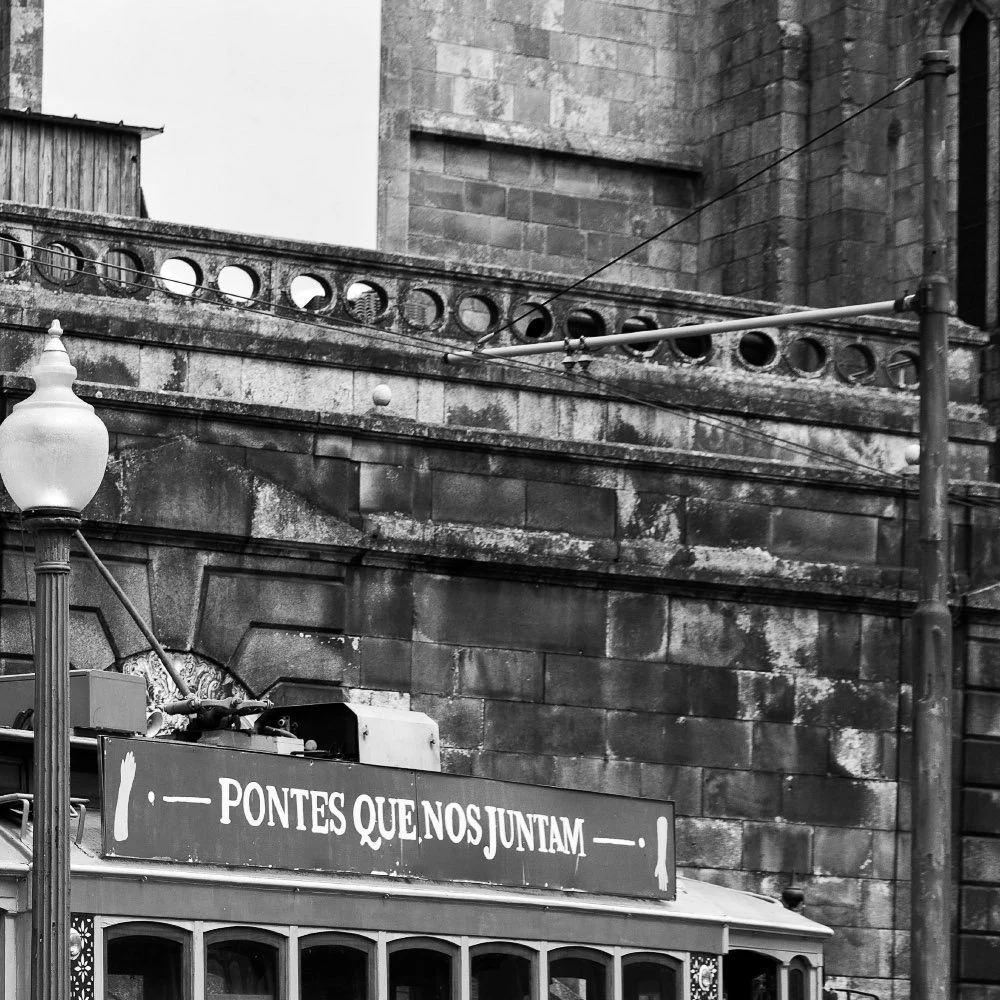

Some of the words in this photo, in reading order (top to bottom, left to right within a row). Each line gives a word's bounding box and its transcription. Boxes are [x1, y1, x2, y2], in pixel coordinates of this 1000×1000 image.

[219, 777, 346, 835] PONTES
[353, 794, 417, 850] QUE
[421, 800, 483, 845] NOS
[483, 805, 587, 859] JUNTAM
